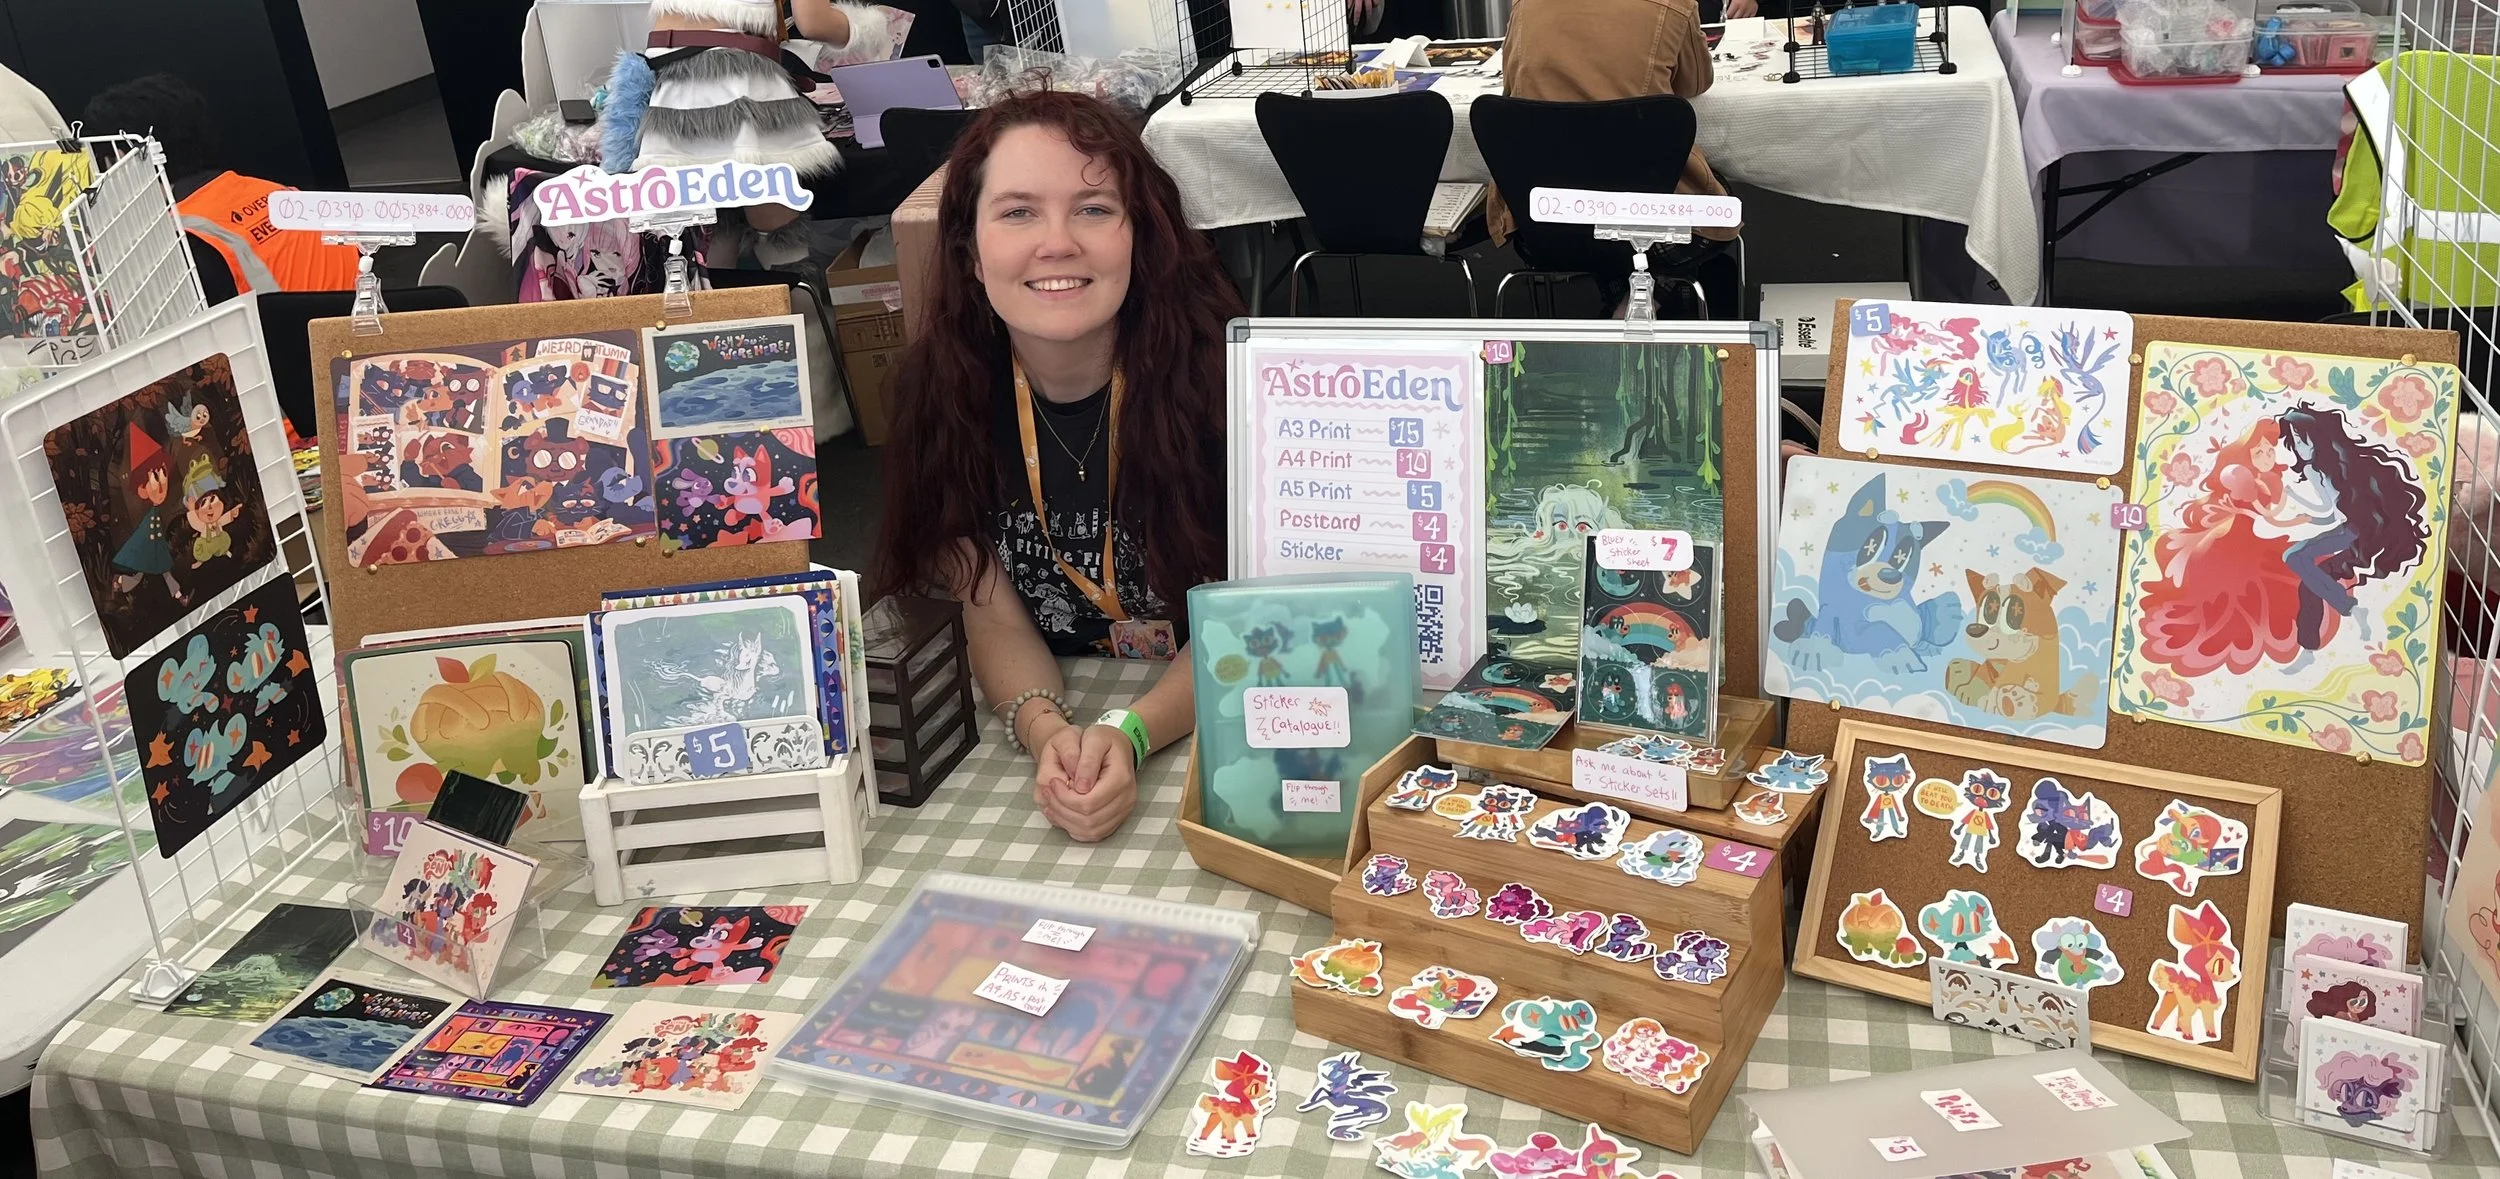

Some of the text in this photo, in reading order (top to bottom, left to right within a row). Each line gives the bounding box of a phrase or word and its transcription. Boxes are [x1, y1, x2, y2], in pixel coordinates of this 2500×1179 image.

[539, 163, 810, 220] AstroEden
[1855, 307, 1883, 333] $5
[542, 341, 581, 354] WEIRD
[1487, 342, 1509, 362] $10
[1262, 364, 1464, 411] AstroEden
[1278, 419, 1419, 444] A3 Print $15
[1277, 449, 1428, 476] A4 Print $10
[1279, 480, 1434, 508] A5 Print $5
[1280, 509, 1441, 540] Postcard $4
[2113, 506, 2142, 527] $10
[1280, 540, 1448, 571] Sticker $4
[1253, 694, 1300, 711] Sticker
[692, 730, 735, 768] $5
[1575, 756, 1653, 779] Ask me about
[1304, 784, 1328, 795] through
[1599, 775, 1640, 793] Sticker
[1722, 845, 1757, 872] $4
[2102, 887, 2125, 912] $4
[994, 967, 1035, 987] PRINTS
